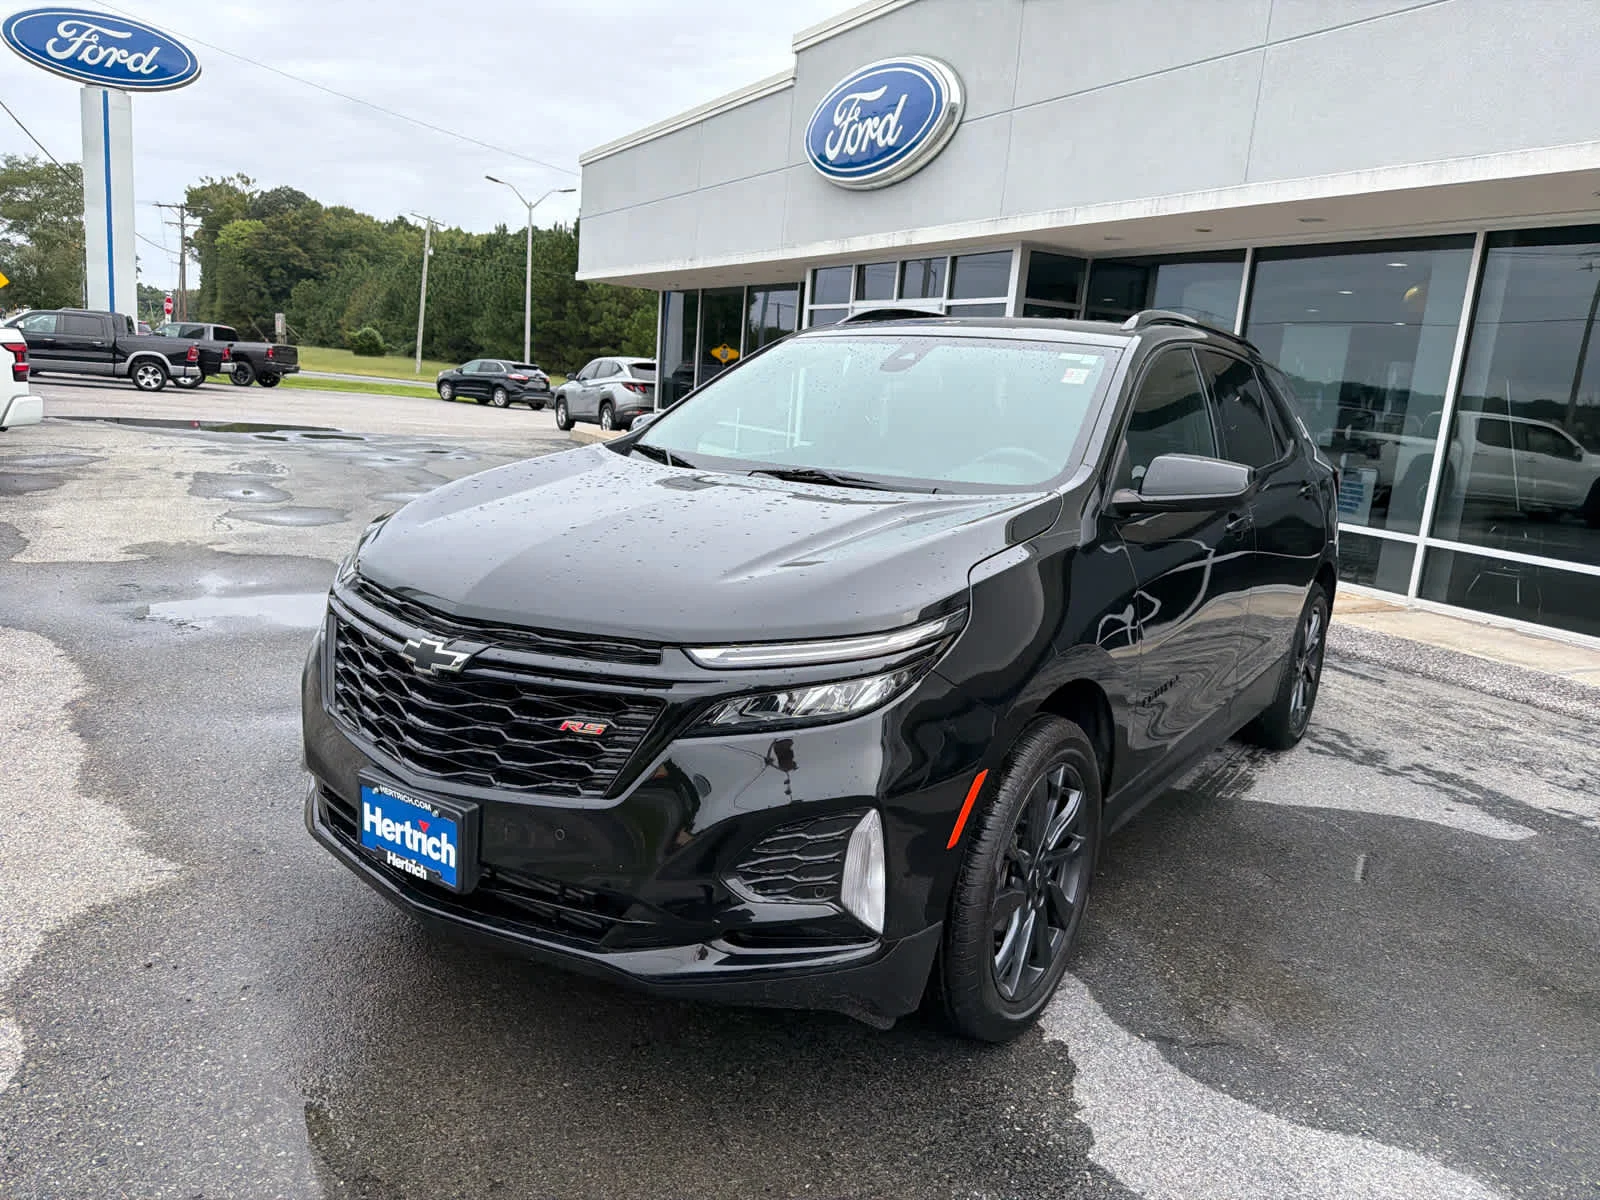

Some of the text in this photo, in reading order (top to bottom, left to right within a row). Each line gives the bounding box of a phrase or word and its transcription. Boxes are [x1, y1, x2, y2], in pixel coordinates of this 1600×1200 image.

[46, 20, 160, 75] Ford
[825, 85, 908, 161] Ford
[560, 720, 607, 735] RS
[379, 785, 432, 813] HERTRICH.COM
[363, 802, 456, 869] Hertrich
[386, 850, 427, 880] Hertrich
